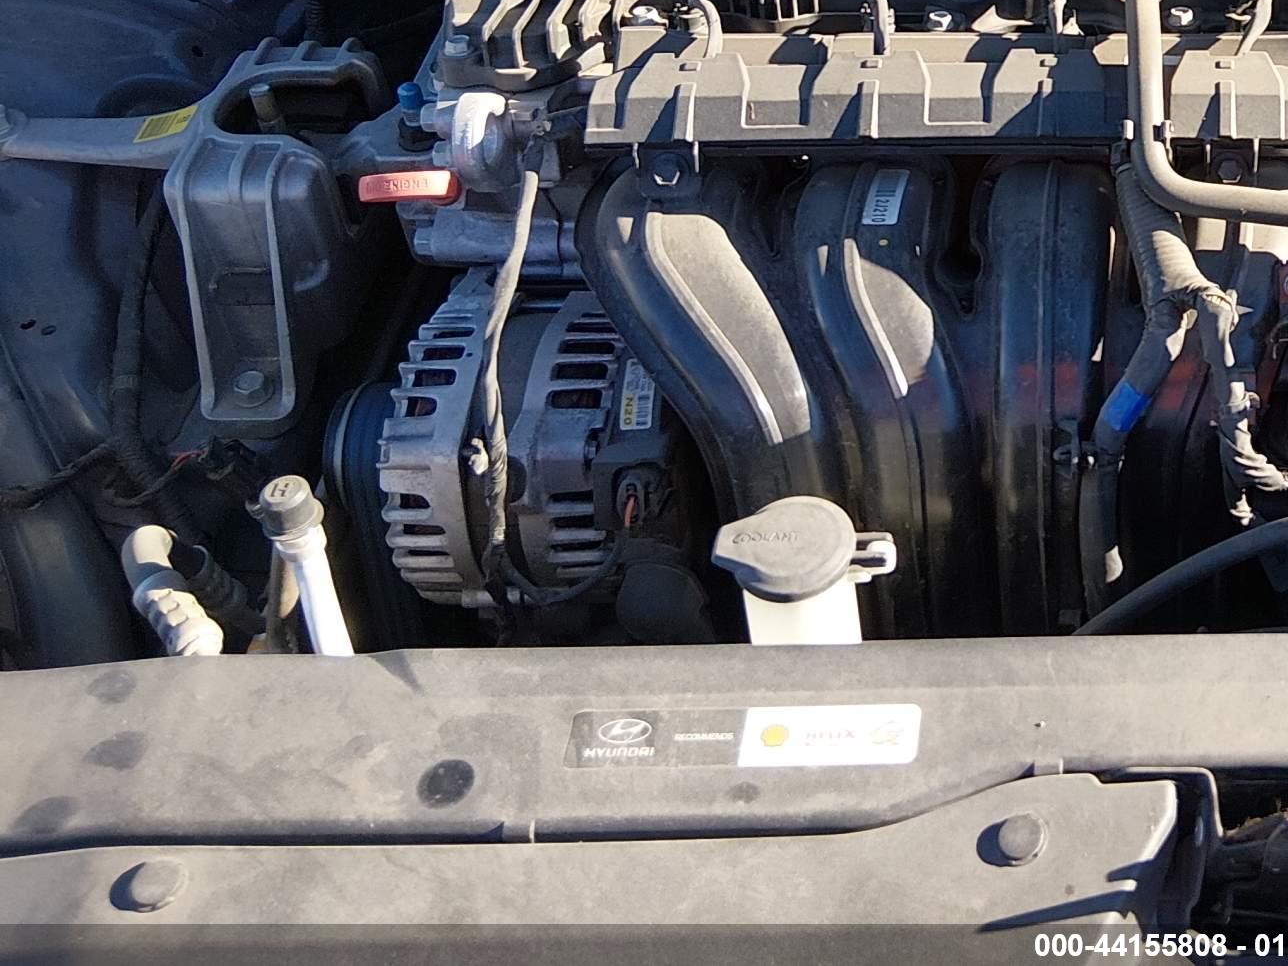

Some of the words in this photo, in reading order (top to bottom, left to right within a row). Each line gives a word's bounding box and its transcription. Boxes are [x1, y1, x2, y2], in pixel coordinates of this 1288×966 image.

[384, 177, 429, 194] ENGINE
[623, 396, 634, 426] N20
[732, 530, 800, 545] COOLANT
[674, 731, 734, 742] RECOMMENDS
[583, 745, 656, 759] HYUNDAI
